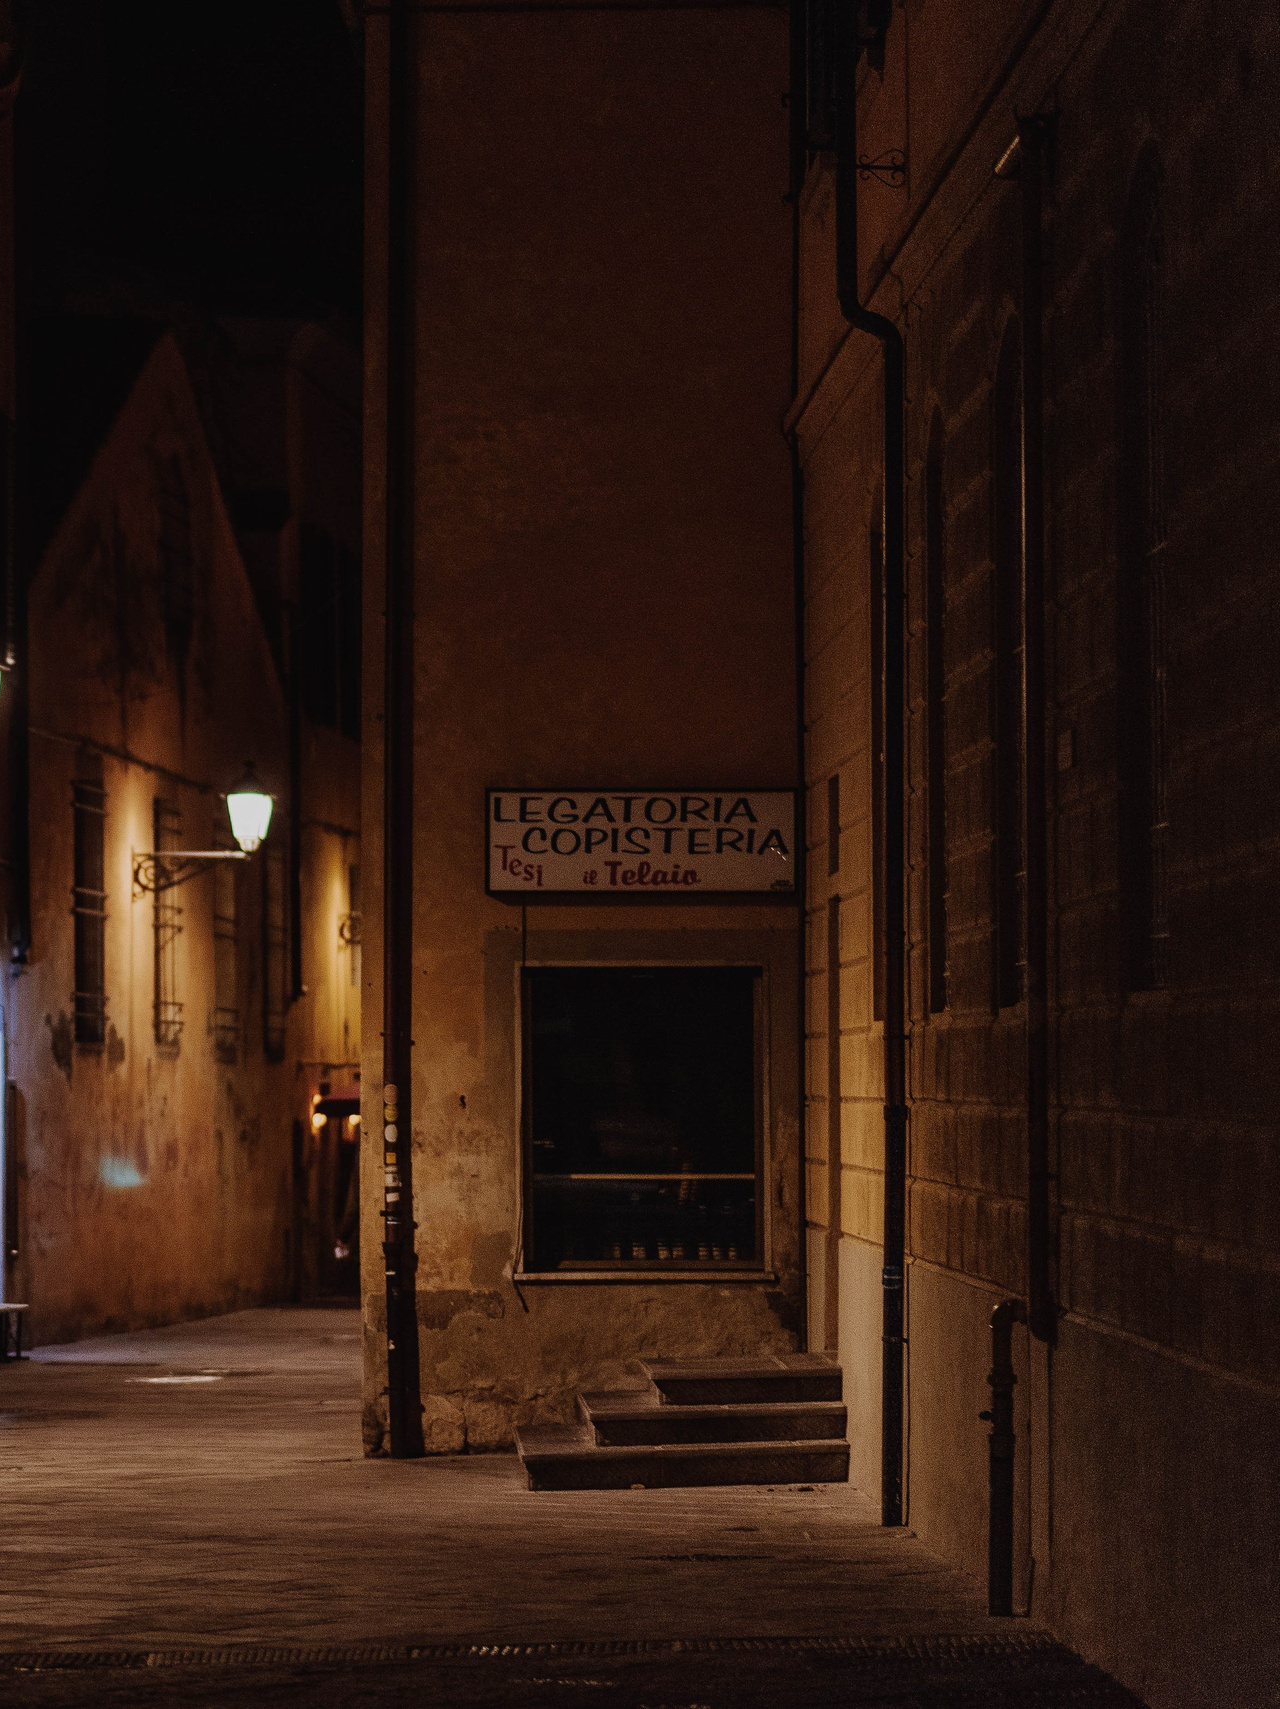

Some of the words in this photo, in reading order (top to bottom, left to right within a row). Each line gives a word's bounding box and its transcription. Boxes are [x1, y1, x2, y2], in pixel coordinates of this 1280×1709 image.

[493, 796, 759, 823] LEGATORIA
[521, 827, 790, 855] COPISTERIA
[494, 844, 544, 887] Tesi
[583, 869, 598, 885] il
[603, 861, 702, 886] Telaio
